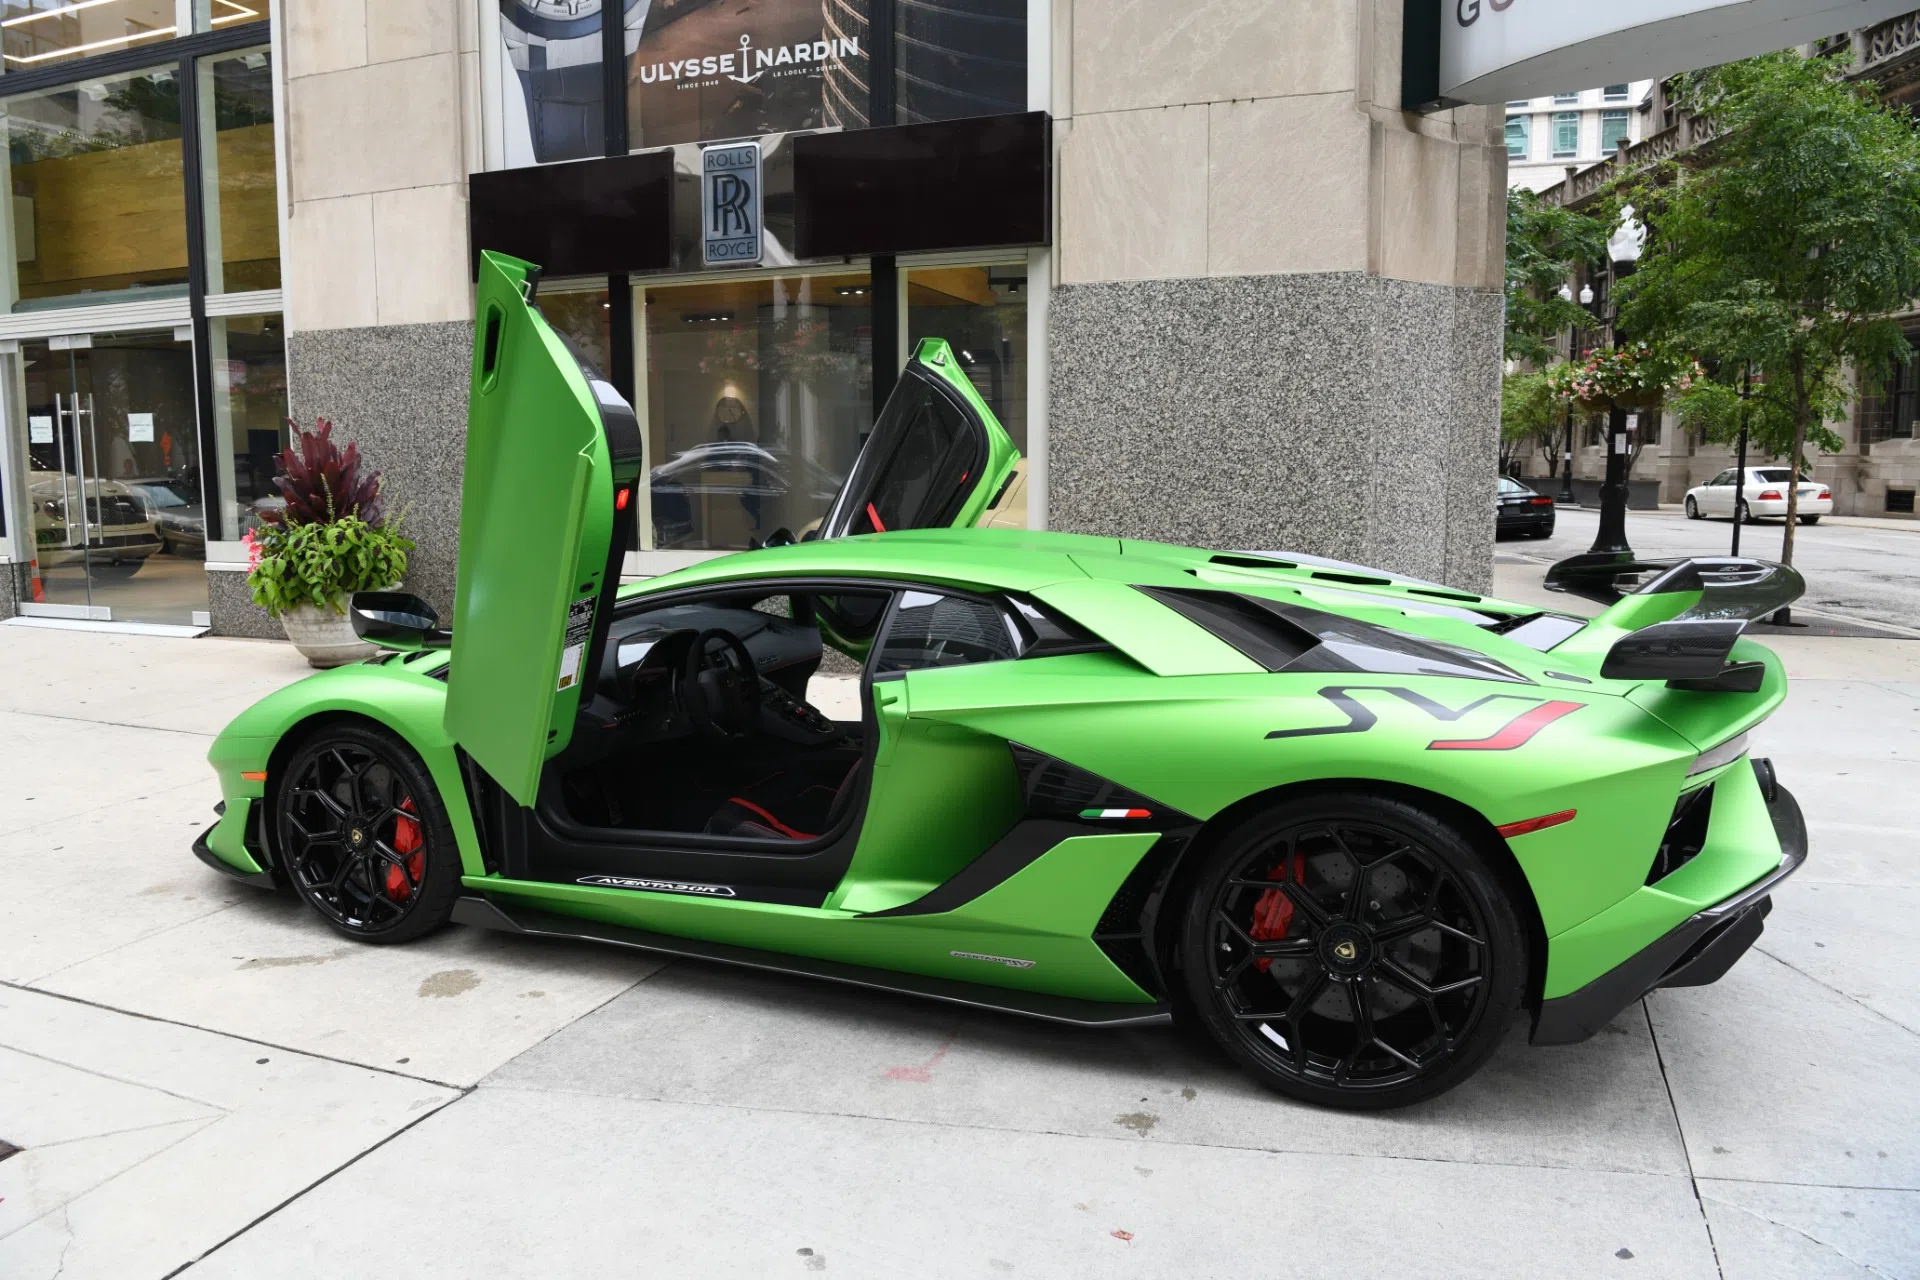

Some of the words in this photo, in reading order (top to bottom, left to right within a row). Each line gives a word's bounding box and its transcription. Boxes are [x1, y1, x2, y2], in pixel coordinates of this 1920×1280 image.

[640, 53, 735, 84] ULYSSE
[755, 36, 859, 69] NARDIN
[784, 68, 807, 76] LOCLE
[676, 82, 699, 90] SINCE
[707, 150, 753, 169] ROLLS
[709, 241, 754, 257] ROYCE
[1263, 685, 1590, 751] SVJ
[597, 877, 719, 893] AVENTADOR
